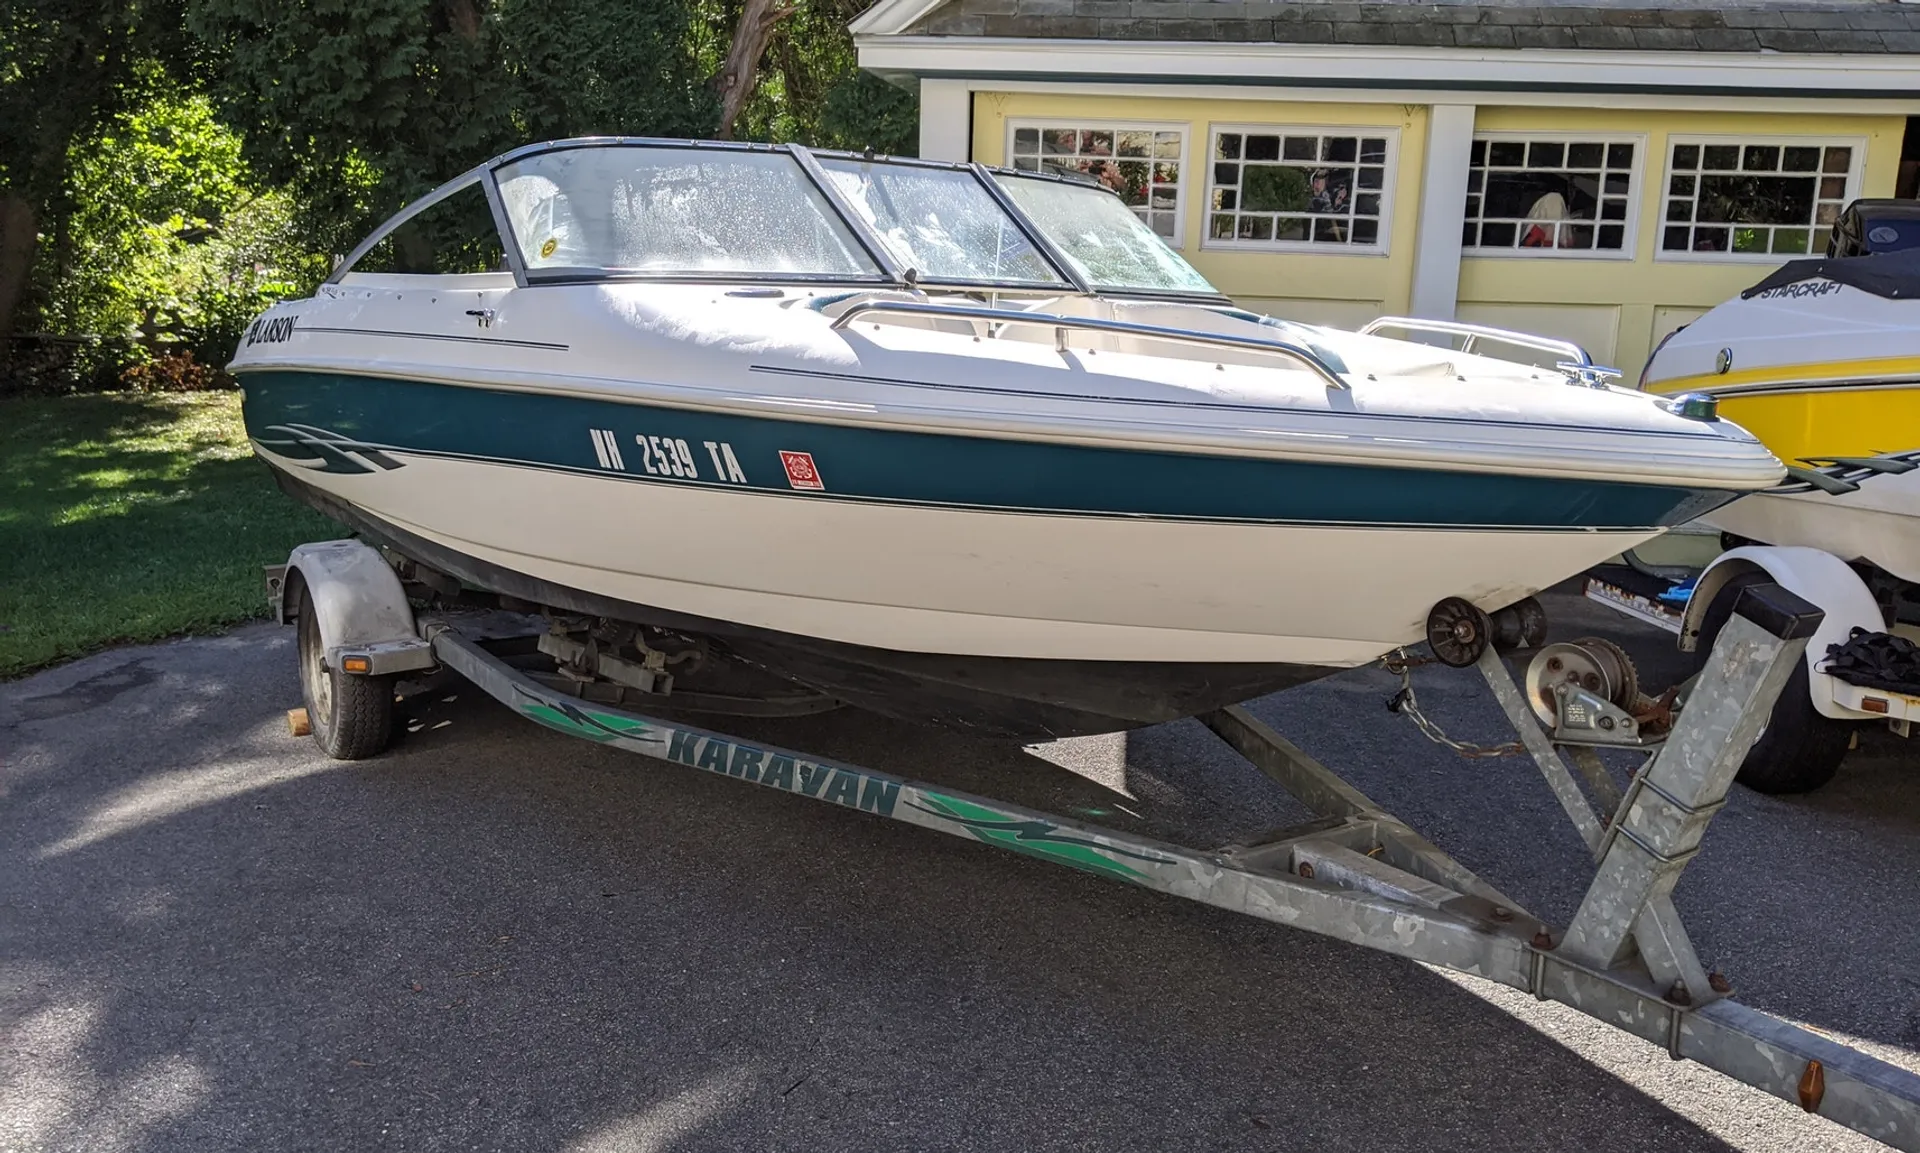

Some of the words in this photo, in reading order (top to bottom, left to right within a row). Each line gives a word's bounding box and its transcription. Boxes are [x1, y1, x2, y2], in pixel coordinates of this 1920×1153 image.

[1761, 281, 1843, 299] STARCRAFT
[255, 315, 299, 343] LARSON
[590, 429, 625, 470] NH
[635, 434, 698, 479] 2539
[703, 441, 748, 484] TA
[667, 729, 902, 818] KARAVAN
